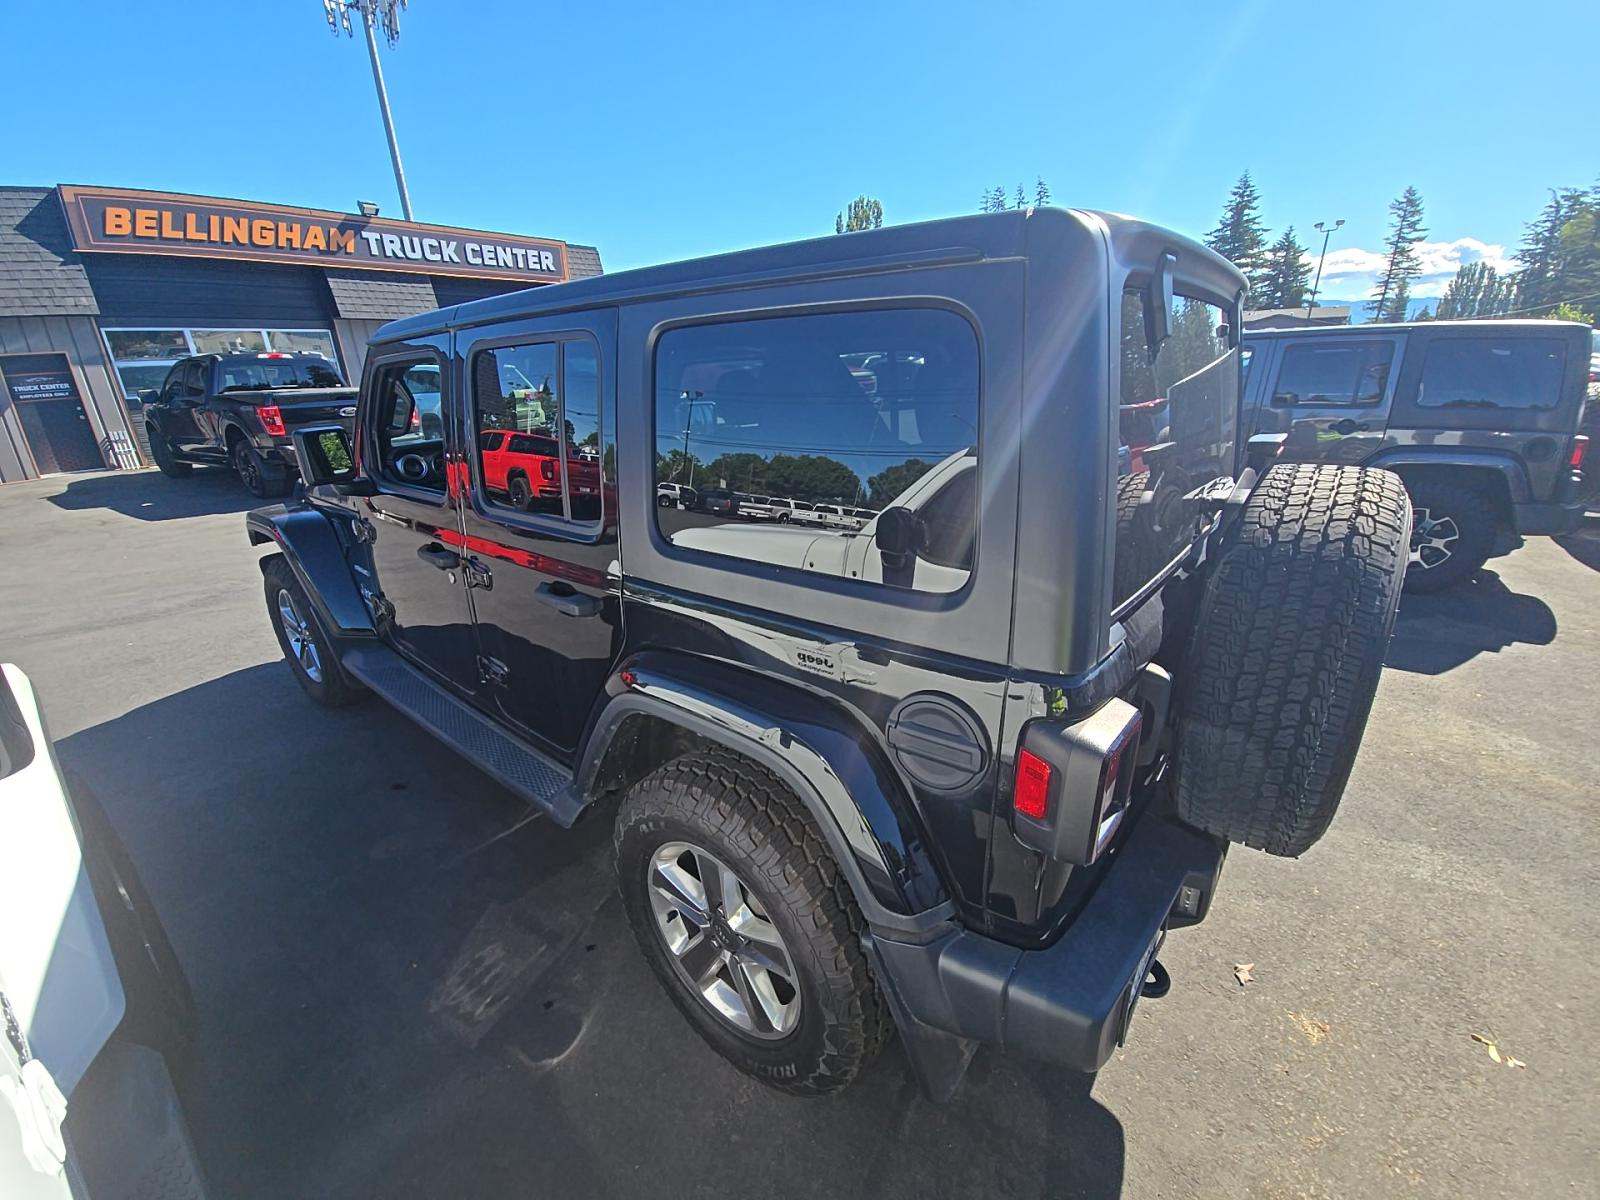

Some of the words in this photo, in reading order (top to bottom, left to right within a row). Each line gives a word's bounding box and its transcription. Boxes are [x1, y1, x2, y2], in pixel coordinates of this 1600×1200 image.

[104, 206, 356, 253] BELLINGHAM
[361, 231, 461, 264] TRUCK
[464, 242, 556, 271] CENTER
